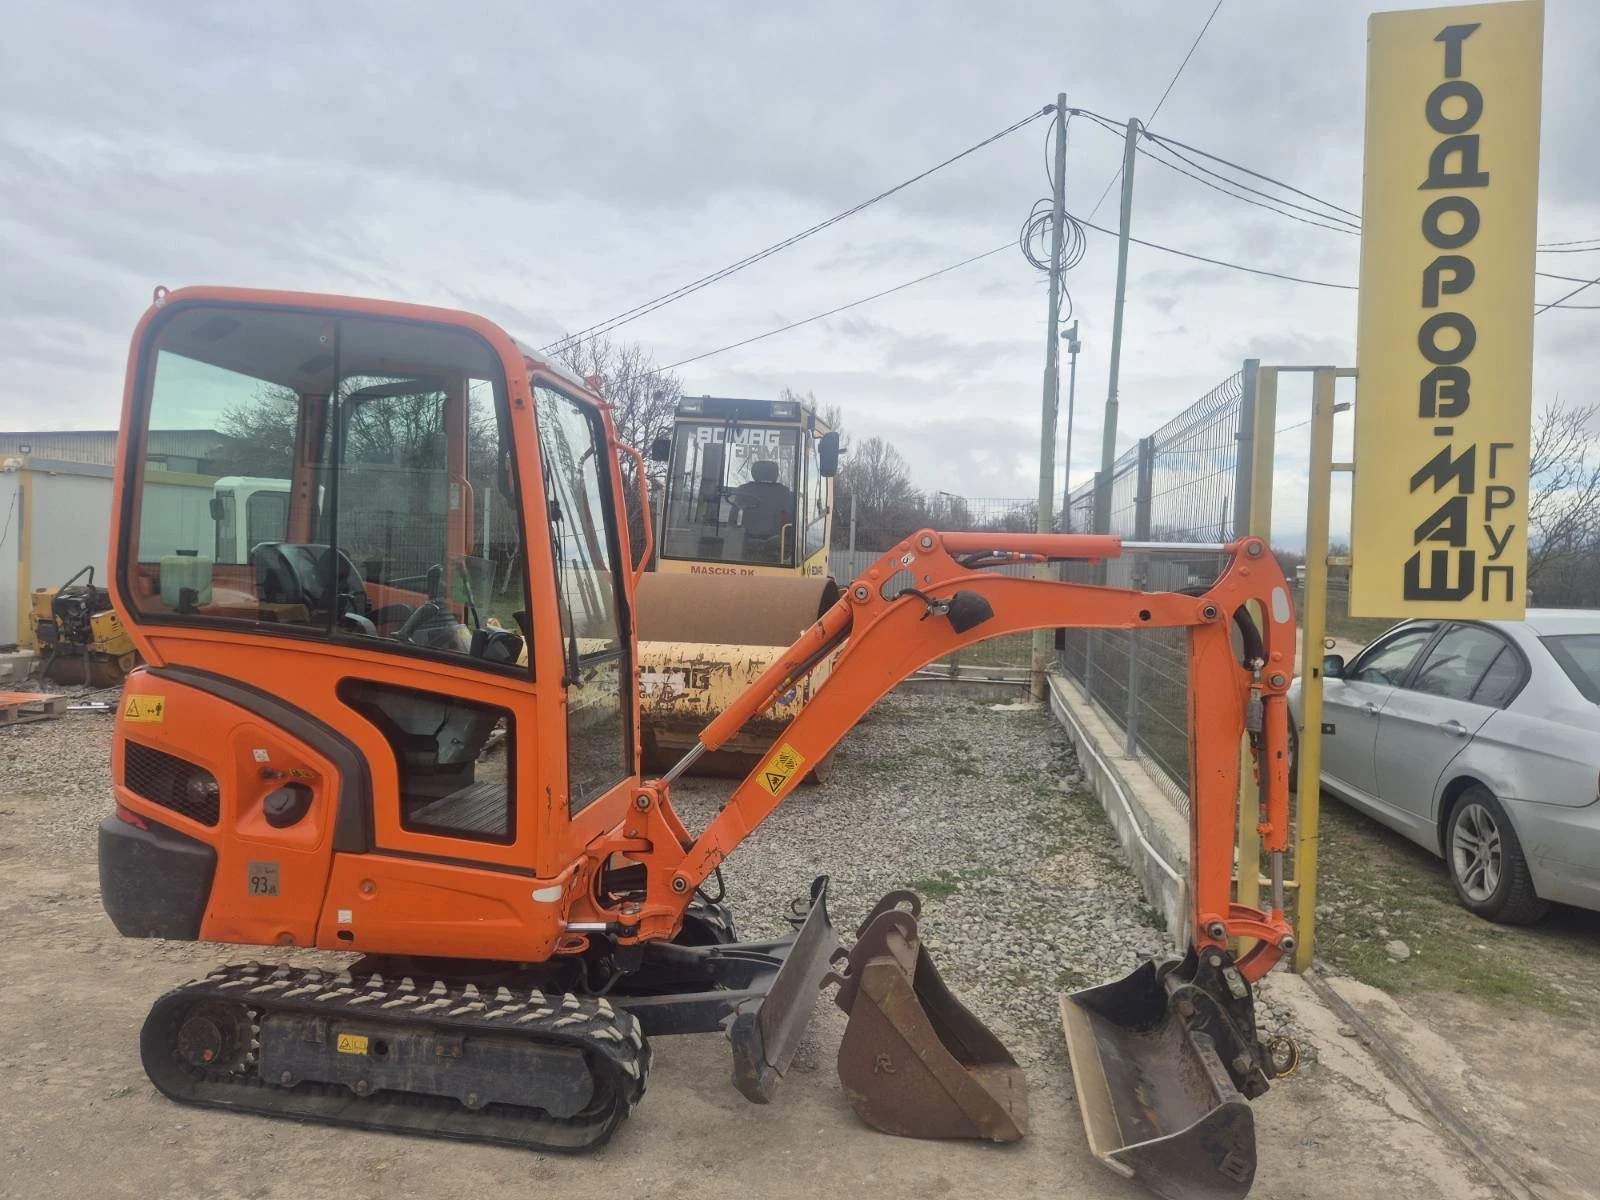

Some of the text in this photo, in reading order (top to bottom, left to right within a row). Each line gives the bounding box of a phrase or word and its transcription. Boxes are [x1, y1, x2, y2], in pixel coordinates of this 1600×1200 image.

[1403, 23, 1489, 602] ТОДОРОВ-МАШ
[1481, 442, 1516, 602] ГРУП
[251, 876, 268, 893] 93
